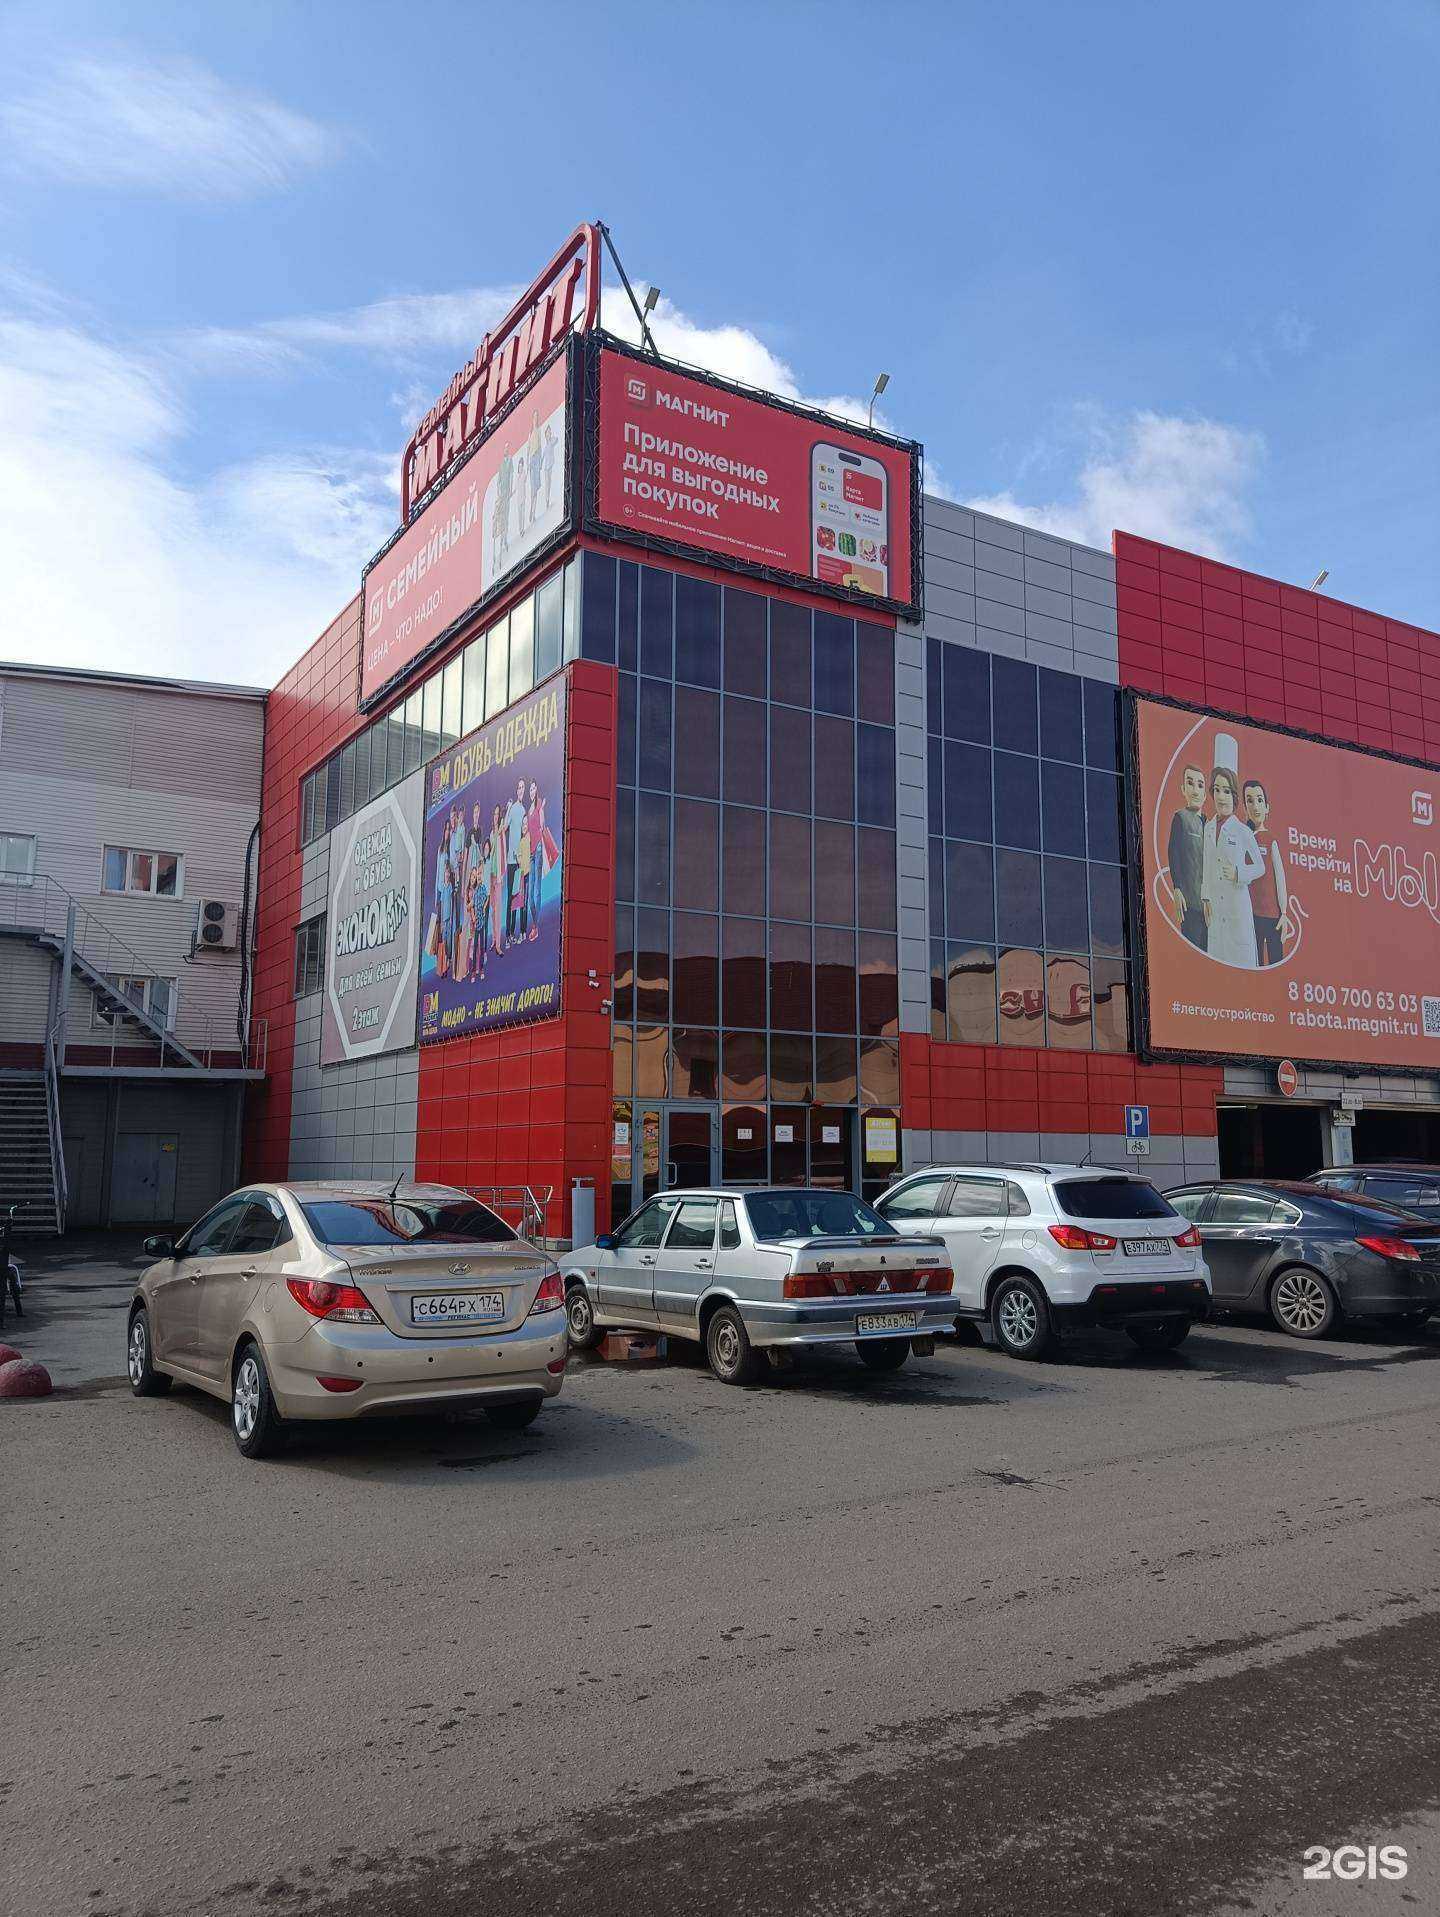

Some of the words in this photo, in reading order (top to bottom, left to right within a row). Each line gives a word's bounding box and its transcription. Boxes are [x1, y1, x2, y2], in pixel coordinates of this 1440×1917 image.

[411, 257, 584, 506] МАГНИТ
[656, 390, 730, 427] МАГНИТ
[624, 422, 768, 485] Приложение
[622, 452, 667, 479] для
[671, 466, 781, 514] выгодных
[623, 477, 720, 520] покупок
[387, 480, 479, 610] СЕМЕЙНЫЙ
[368, 640, 389, 673] ЦЕНА
[395, 615, 412, 646] ЧТО
[414, 586, 444, 626] НАДО!
[453, 737, 492, 791] ОБУВЬ
[495, 690, 558, 768] ОДЕЖДА
[354, 822, 392, 866] ОДЕЖДА
[1288, 827, 1337, 852] Время
[363, 855, 392, 892] ОБУВЬ
[1289, 851, 1351, 874] перейти
[1334, 878, 1353, 894] на
[474, 1001, 484, 1019] НЕ
[486, 991, 516, 1017] ЗНАЧИТ
[516, 982, 554, 1013] ДОРОГО!
[1171, 1000, 1276, 1023] #легкоустройство
[1288, 981, 1299, 1001] 8
[1303, 982, 1337, 1005] 800
[1340, 986, 1372, 1009] 700
[1376, 991, 1395, 1011] 63
[1399, 993, 1418, 1014] 03
[1289, 1008, 1418, 1037] rabota.magnit.ru
[1130, 1109, 1143, 1136] P
